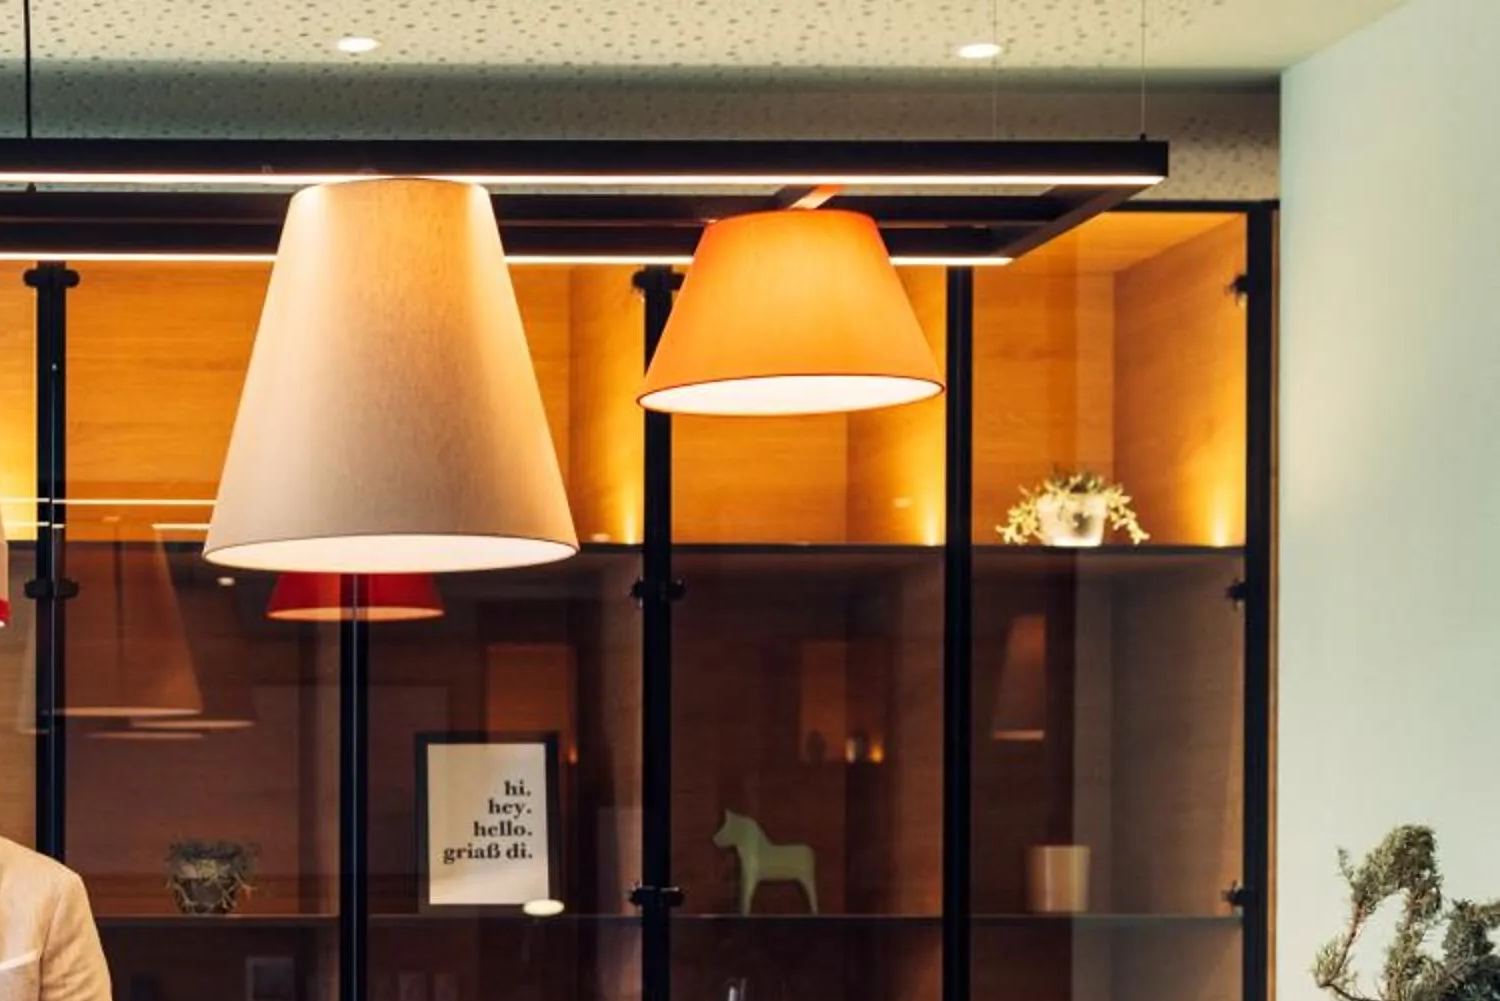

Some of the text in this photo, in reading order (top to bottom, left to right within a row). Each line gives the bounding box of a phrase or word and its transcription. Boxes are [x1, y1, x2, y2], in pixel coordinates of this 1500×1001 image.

[504, 779, 531, 797] hi.
[486, 798, 532, 819] hey.
[473, 821, 533, 837] hello.
[443, 842, 533, 865] griaß di.
